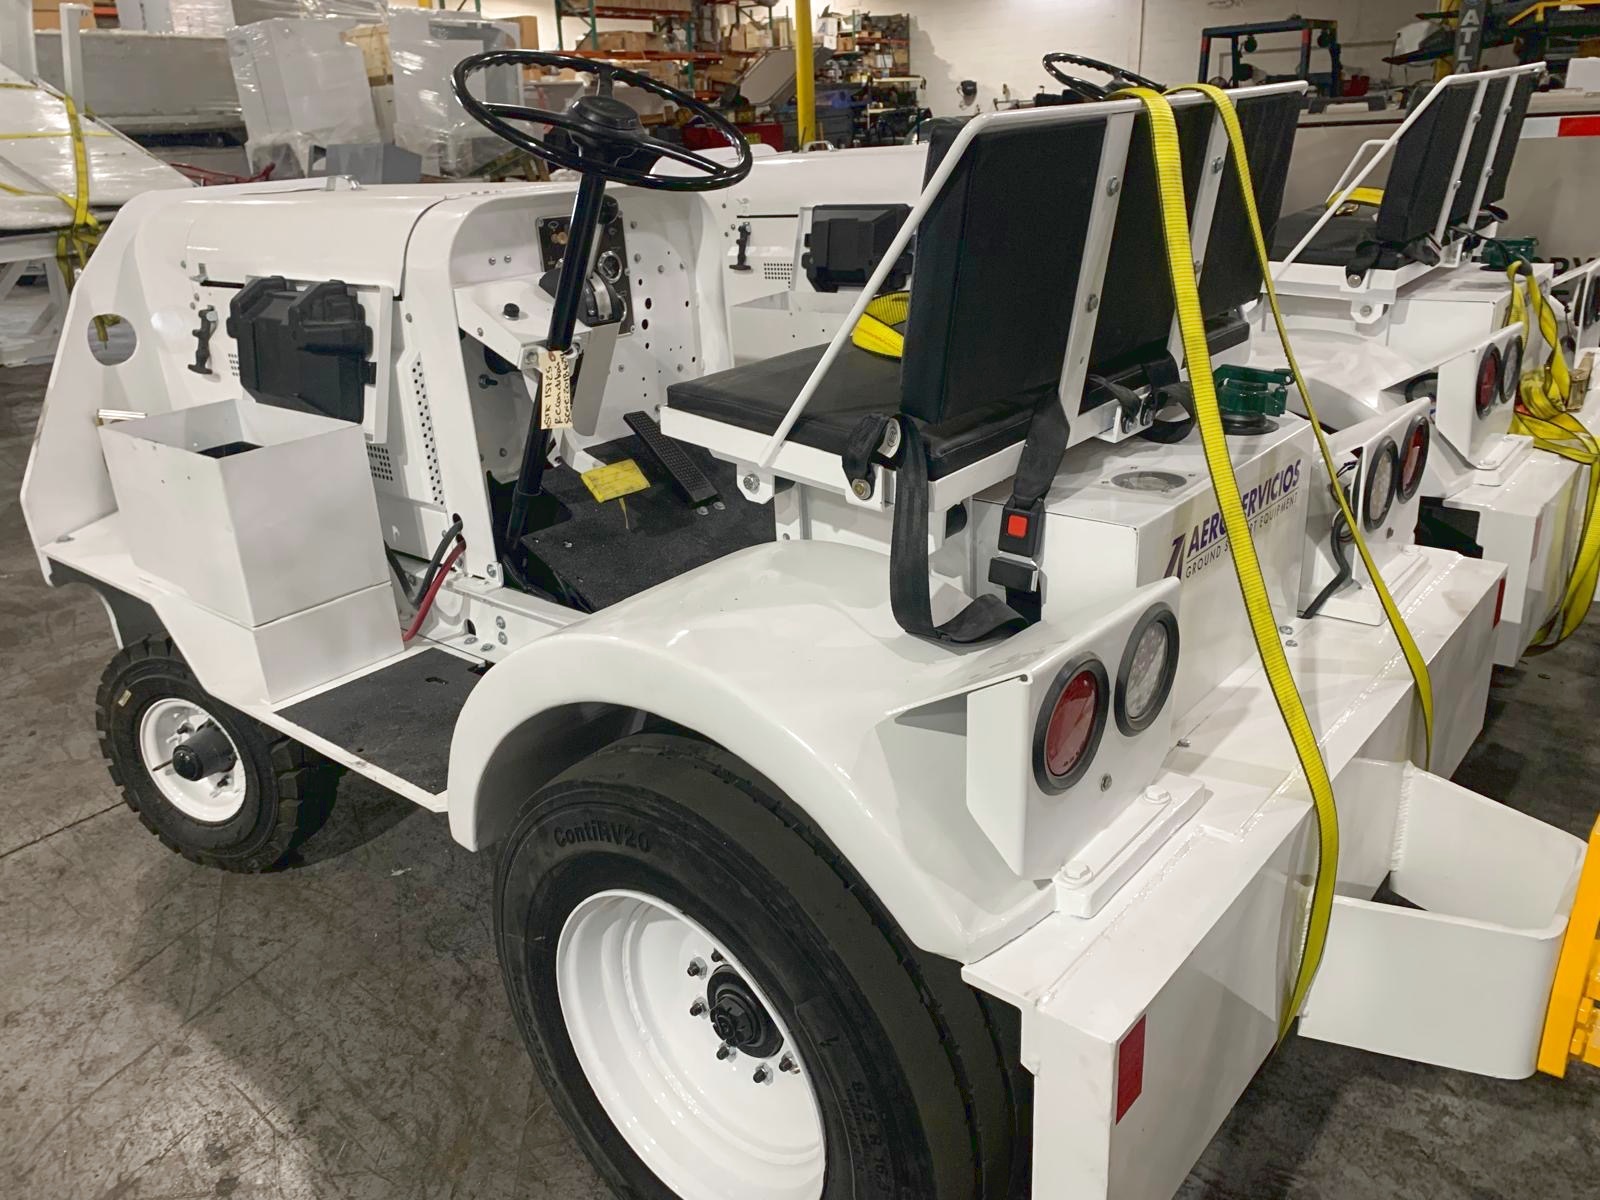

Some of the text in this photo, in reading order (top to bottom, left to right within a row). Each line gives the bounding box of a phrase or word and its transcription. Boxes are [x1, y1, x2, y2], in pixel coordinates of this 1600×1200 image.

[1185, 491, 1299, 579] GROUND EQUIPMENT
[554, 819, 651, 853] ContiRV20
